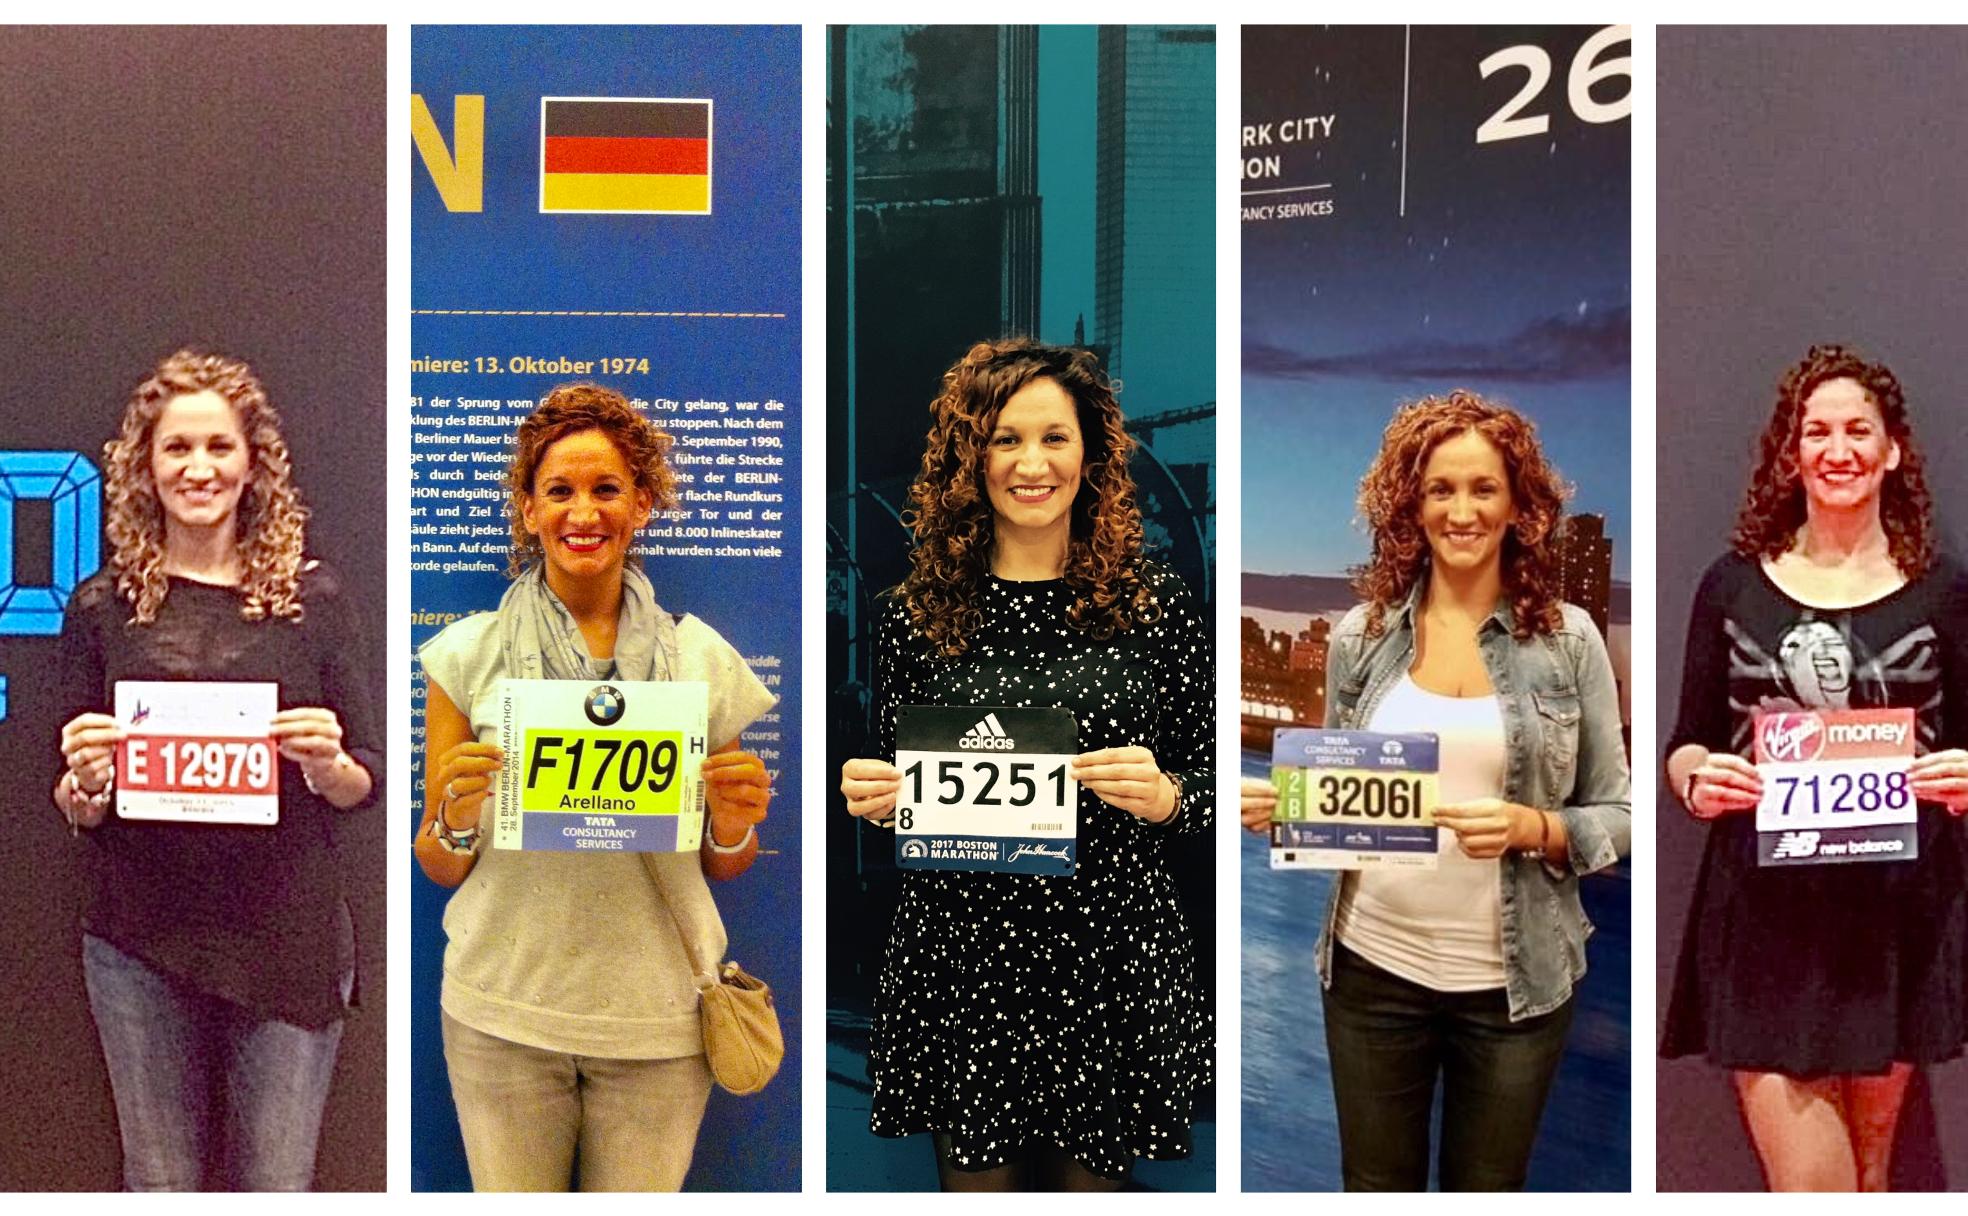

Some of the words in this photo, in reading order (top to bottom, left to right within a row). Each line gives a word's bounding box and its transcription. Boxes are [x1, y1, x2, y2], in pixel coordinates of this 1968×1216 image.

[1475, 25, 1632, 144] 26
[1279, 114, 1336, 143] CITY
[1277, 200, 1334, 219] SERVICES
[474, 357, 505, 373] 13.
[509, 356, 593, 374] Oktober
[600, 358, 650, 375] 1974
[430, 397, 451, 408] der
[457, 397, 500, 410] Sprung
[507, 399, 533, 409] vom
[630, 399, 649, 410] die
[655, 399, 679, 412] City
[685, 400, 730, 413] gelang,
[736, 402, 758, 411] war
[764, 400, 785, 411] die
[445, 416, 466, 426] des
[653, 420, 667, 428] zu
[669, 419, 722, 430] stoppen.
[724, 418, 754, 429] Nach
[756, 418, 784, 429] dem
[415, 433, 461, 444] Berliner
[464, 434, 501, 444] Mauer
[682, 436, 748, 449] September
[752, 437, 784, 448] 1990,
[427, 453, 445, 462] vor
[449, 451, 468, 462] der
[675, 454, 713, 465] führte
[716, 454, 735, 465] die
[738, 454, 784, 466] Strecke
[430, 470, 464, 480] durch
[704, 473, 726, 483] der
[735, 473, 783, 484] BERLIN-
[442, 487, 500, 501] endgültig
[686, 490, 722, 501] flache
[725, 491, 783, 502] Rundkurs
[436, 506, 460, 517] und
[469, 506, 491, 517] Ziel
[700, 509, 720, 520] Tor
[728, 509, 752, 520] und
[761, 510, 783, 520] der
[440, 524, 469, 535] zieht
[471, 524, 504, 537] jedes
[648, 527, 672, 537] und
[675, 527, 709, 538] 8.000
[711, 527, 783, 539] Inlineskater
[423, 542, 456, 553] Bann.
[459, 542, 480, 553] Auf
[482, 542, 508, 553] dem
[667, 545, 713, 556] wurden
[715, 545, 751, 557] schon
[753, 546, 783, 557] viele
[443, 560, 499, 573] gelaufen.
[502, 697, 512, 790] BERLIN-MARATHON
[959, 735, 1015, 750] adidas
[1765, 712, 1821, 760] Virgin
[1828, 721, 1908, 747] money
[690, 737, 704, 754] H
[127, 740, 149, 785] E
[160, 741, 271, 789] 12979
[511, 751, 520, 770] 2014
[526, 737, 678, 793] F1709
[1379, 756, 1406, 766] TATA
[905, 760, 1066, 807] 15251
[510, 772, 520, 816] September
[1319, 776, 1421, 819] 32061
[1775, 771, 1909, 816] 71288
[501, 793, 510, 816] BMW
[559, 795, 636, 811] Arellano
[584, 816, 616, 827] TATA
[899, 807, 914, 830] 8
[562, 828, 637, 839] CONSULTANCY
[576, 839, 624, 850] SERVICES
[931, 840, 953, 849] 2017
[956, 840, 997, 850] BOSTON
[1820, 843, 1848, 855] new
[1848, 838, 1905, 854] balance
